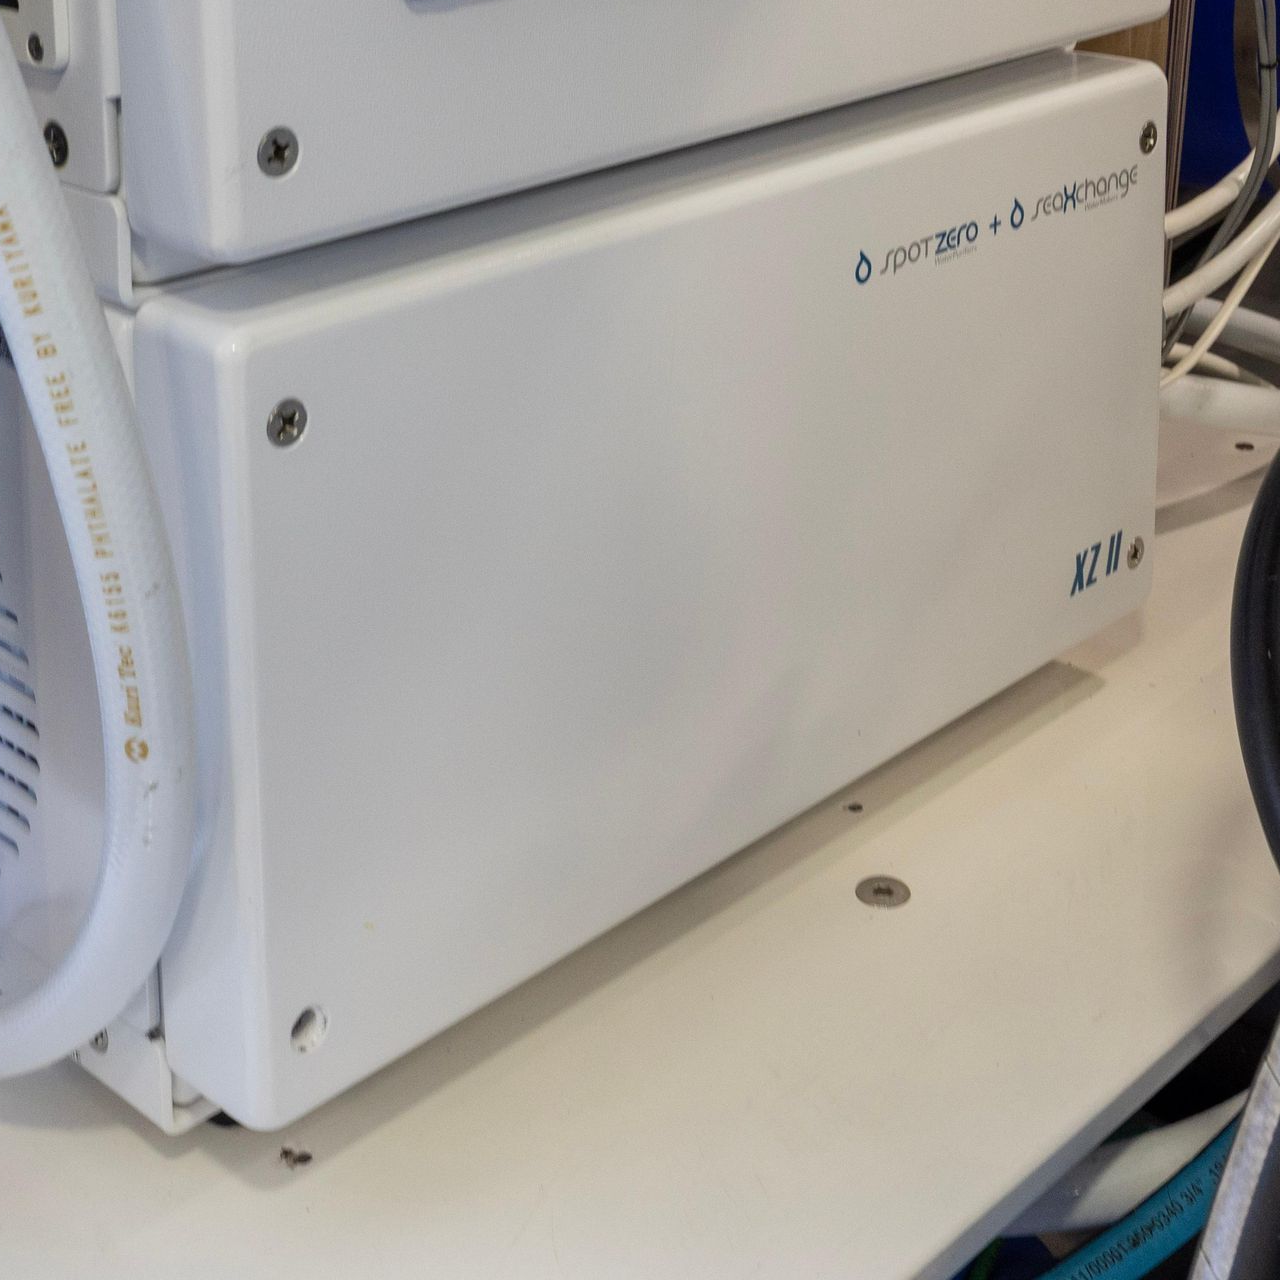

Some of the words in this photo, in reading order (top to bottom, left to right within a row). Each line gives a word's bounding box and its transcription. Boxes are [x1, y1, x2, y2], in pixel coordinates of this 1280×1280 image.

[33, 334, 57, 360] BY
[44, 371, 78, 429] FREE
[1070, 540, 1102, 597] XZ
